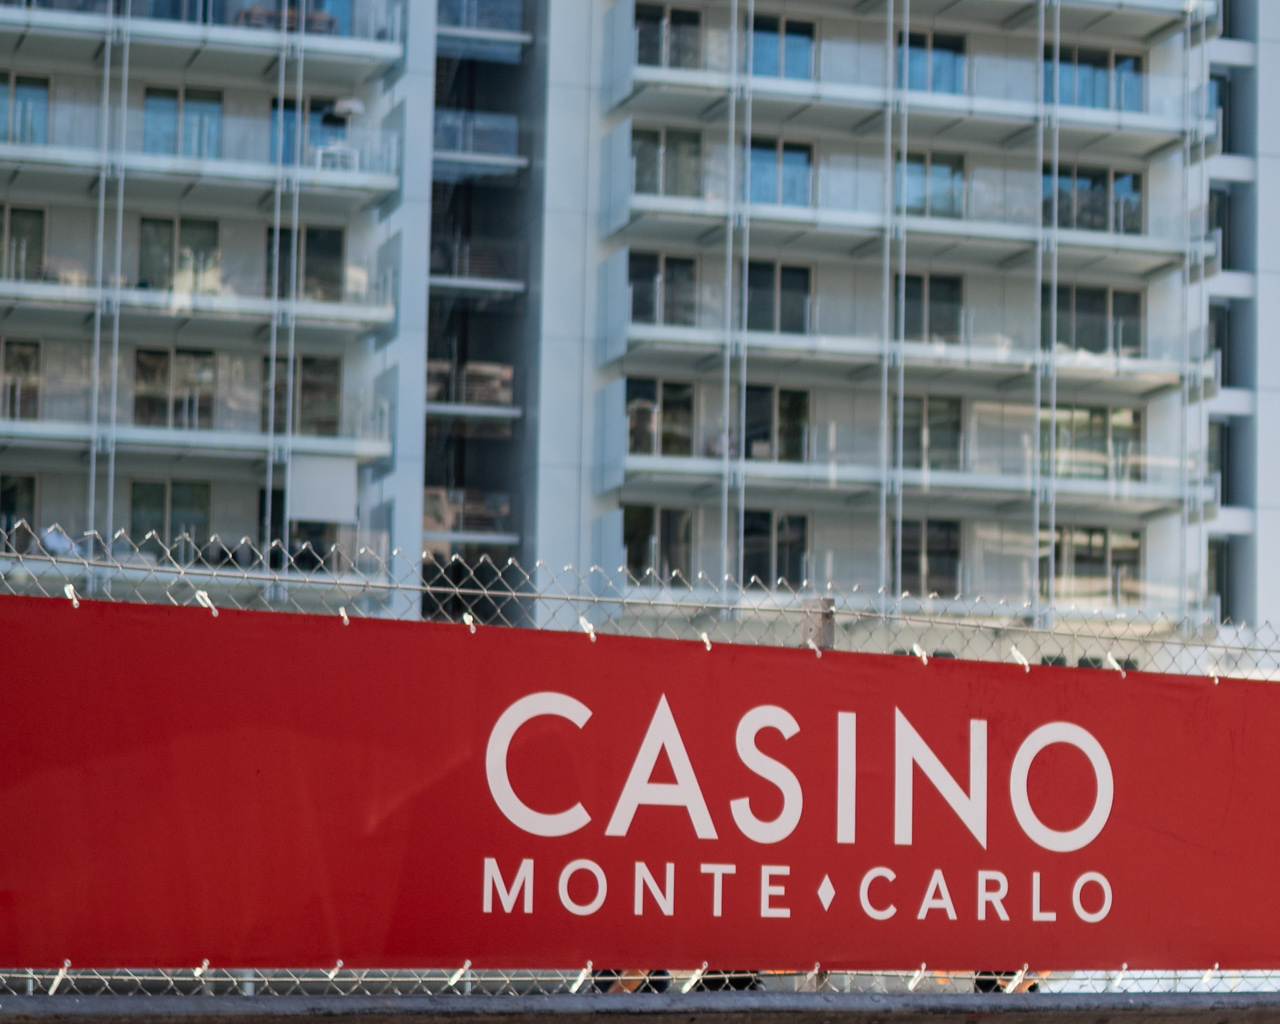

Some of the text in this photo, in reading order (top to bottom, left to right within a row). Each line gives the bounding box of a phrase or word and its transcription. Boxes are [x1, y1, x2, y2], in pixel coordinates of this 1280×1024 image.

[486, 691, 1114, 853] CASINO
[482, 858, 1113, 923] MONTE CARLO
